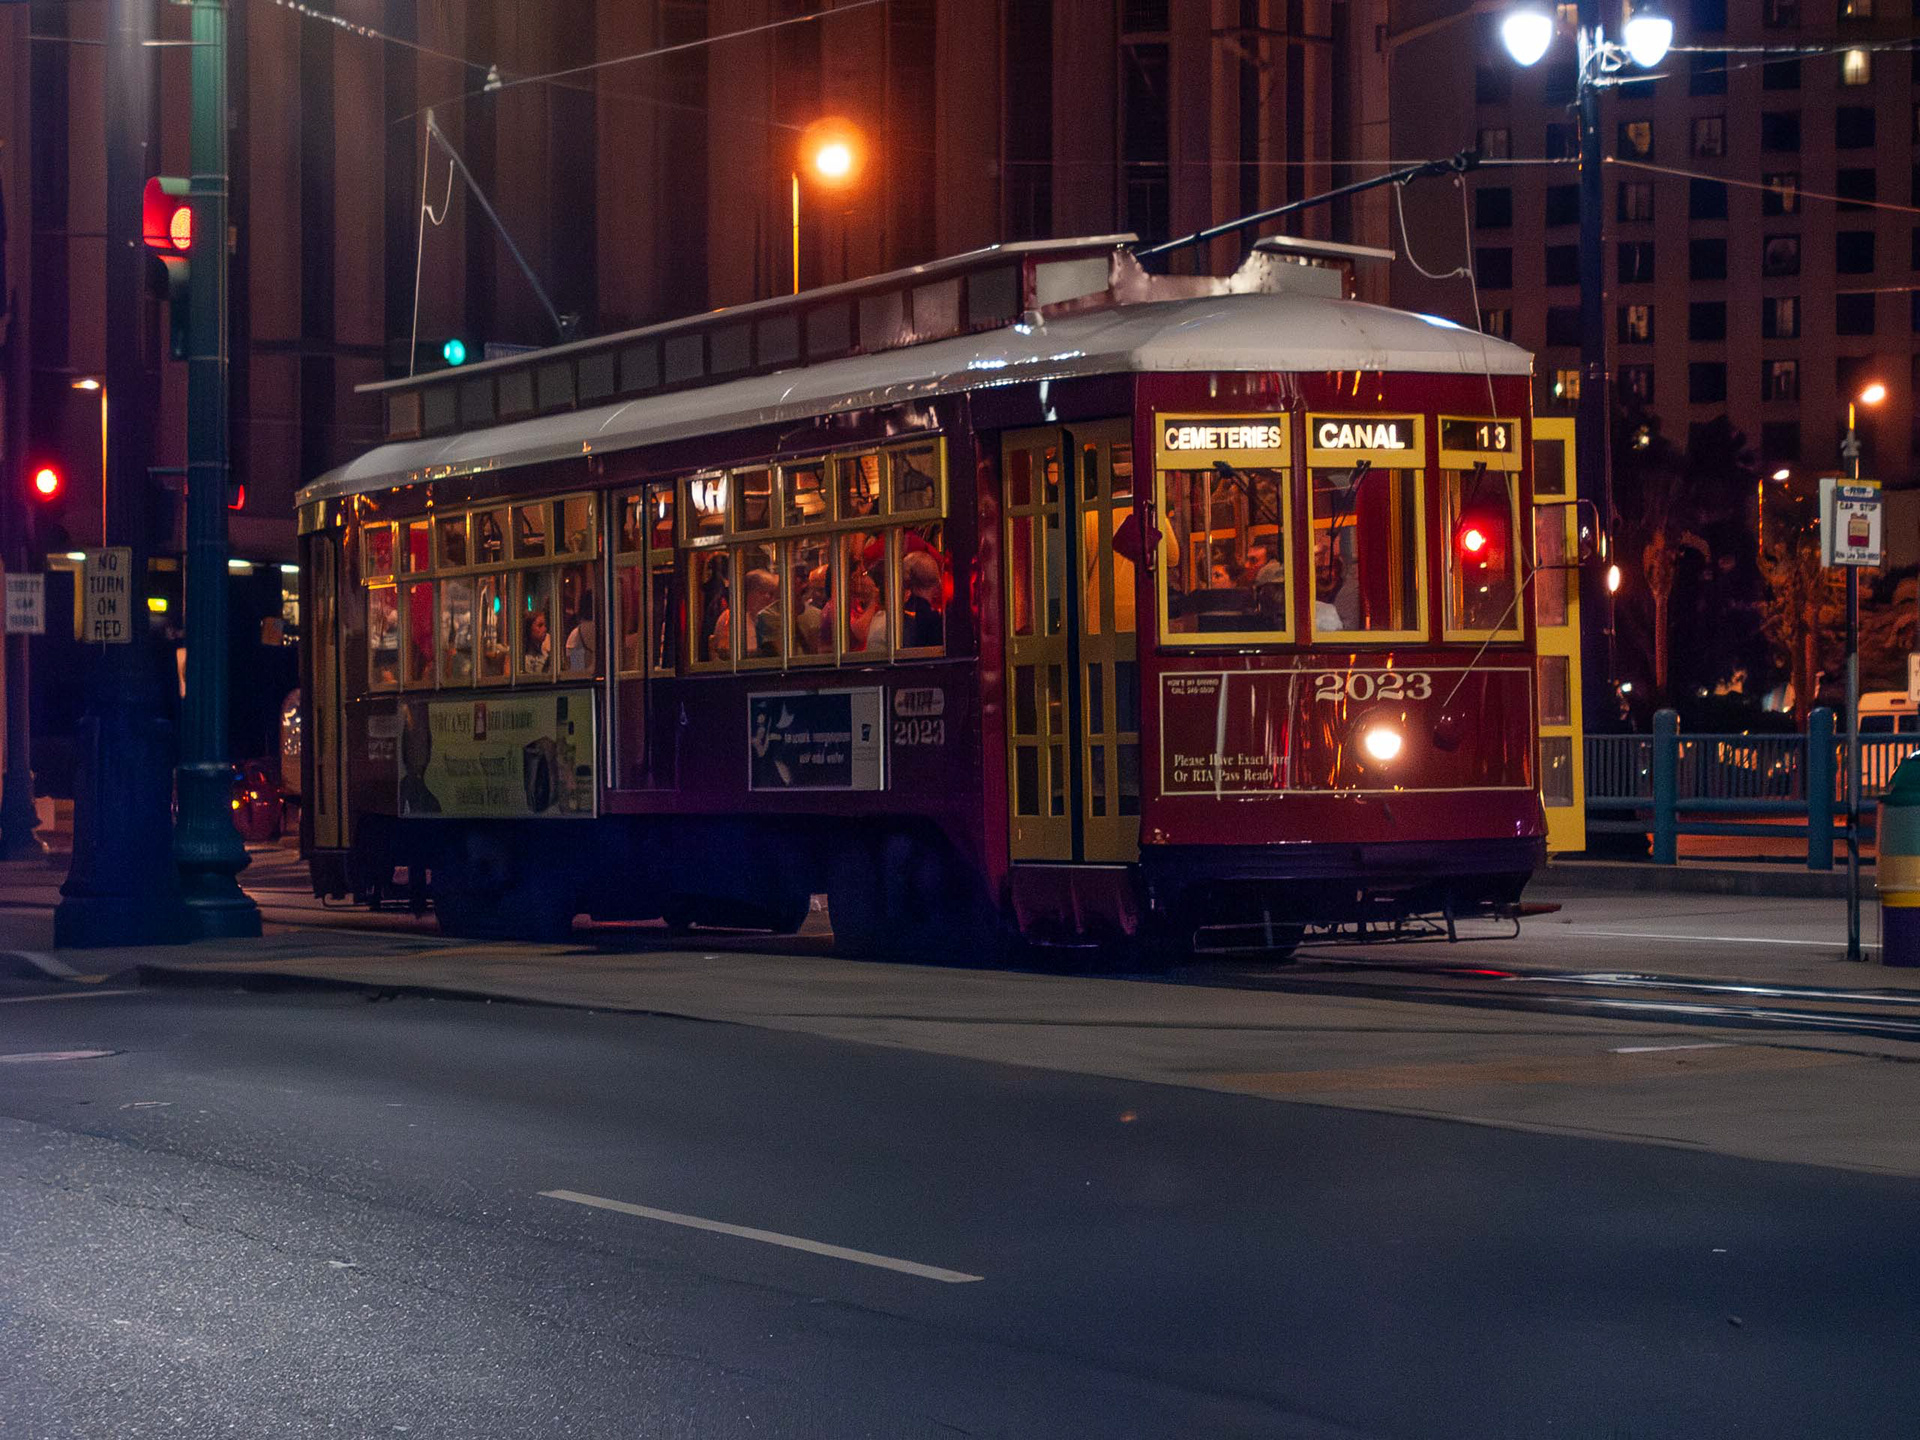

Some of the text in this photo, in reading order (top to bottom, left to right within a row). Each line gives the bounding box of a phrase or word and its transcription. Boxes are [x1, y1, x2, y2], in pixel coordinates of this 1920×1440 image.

[1165, 426, 1281, 450] CEMETERIES
[1319, 423, 1405, 450] CANAL
[1477, 426, 1506, 449] 13
[99, 553, 117, 571] NO
[89, 576, 124, 594] TURN
[97, 598, 116, 616] ON
[94, 620, 121, 639] RED
[1315, 672, 1432, 702] 2023
[894, 718, 945, 745] 2023
[1174, 754, 1206, 766] Please
[1238, 752, 1265, 766] Exact
[1174, 768, 1274, 784] Or RTA Pass Ready
